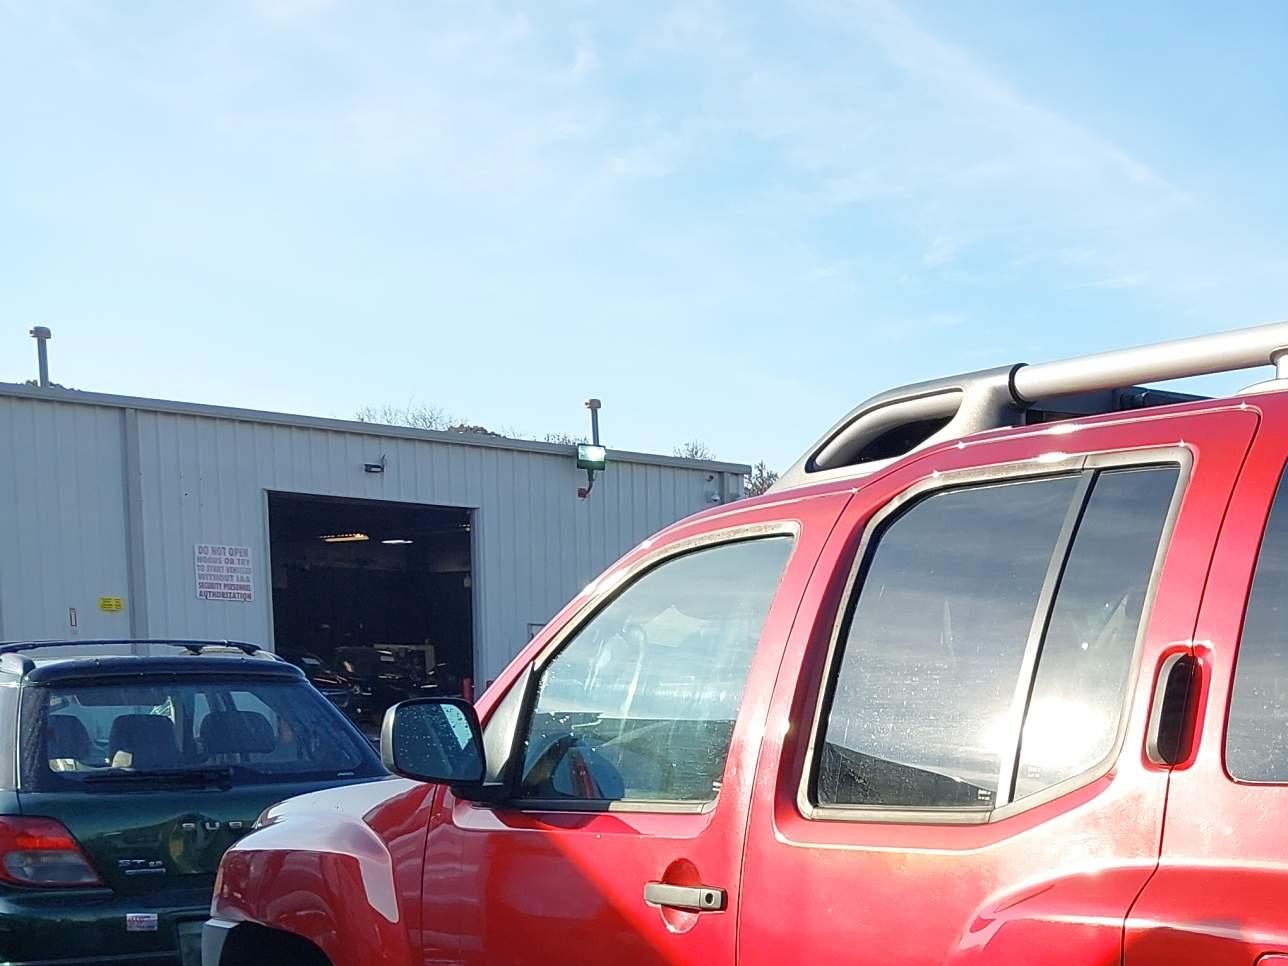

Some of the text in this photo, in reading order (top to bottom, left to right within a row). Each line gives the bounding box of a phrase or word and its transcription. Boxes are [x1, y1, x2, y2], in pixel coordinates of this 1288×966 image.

[198, 546, 249, 557] DO NOT OPEN
[224, 557, 235, 565] OR
[236, 558, 250, 566] TRY
[198, 573, 234, 582] WITHOUT
[198, 582, 222, 590] SECURITY
[199, 590, 252, 599] AUTHORIZATION
